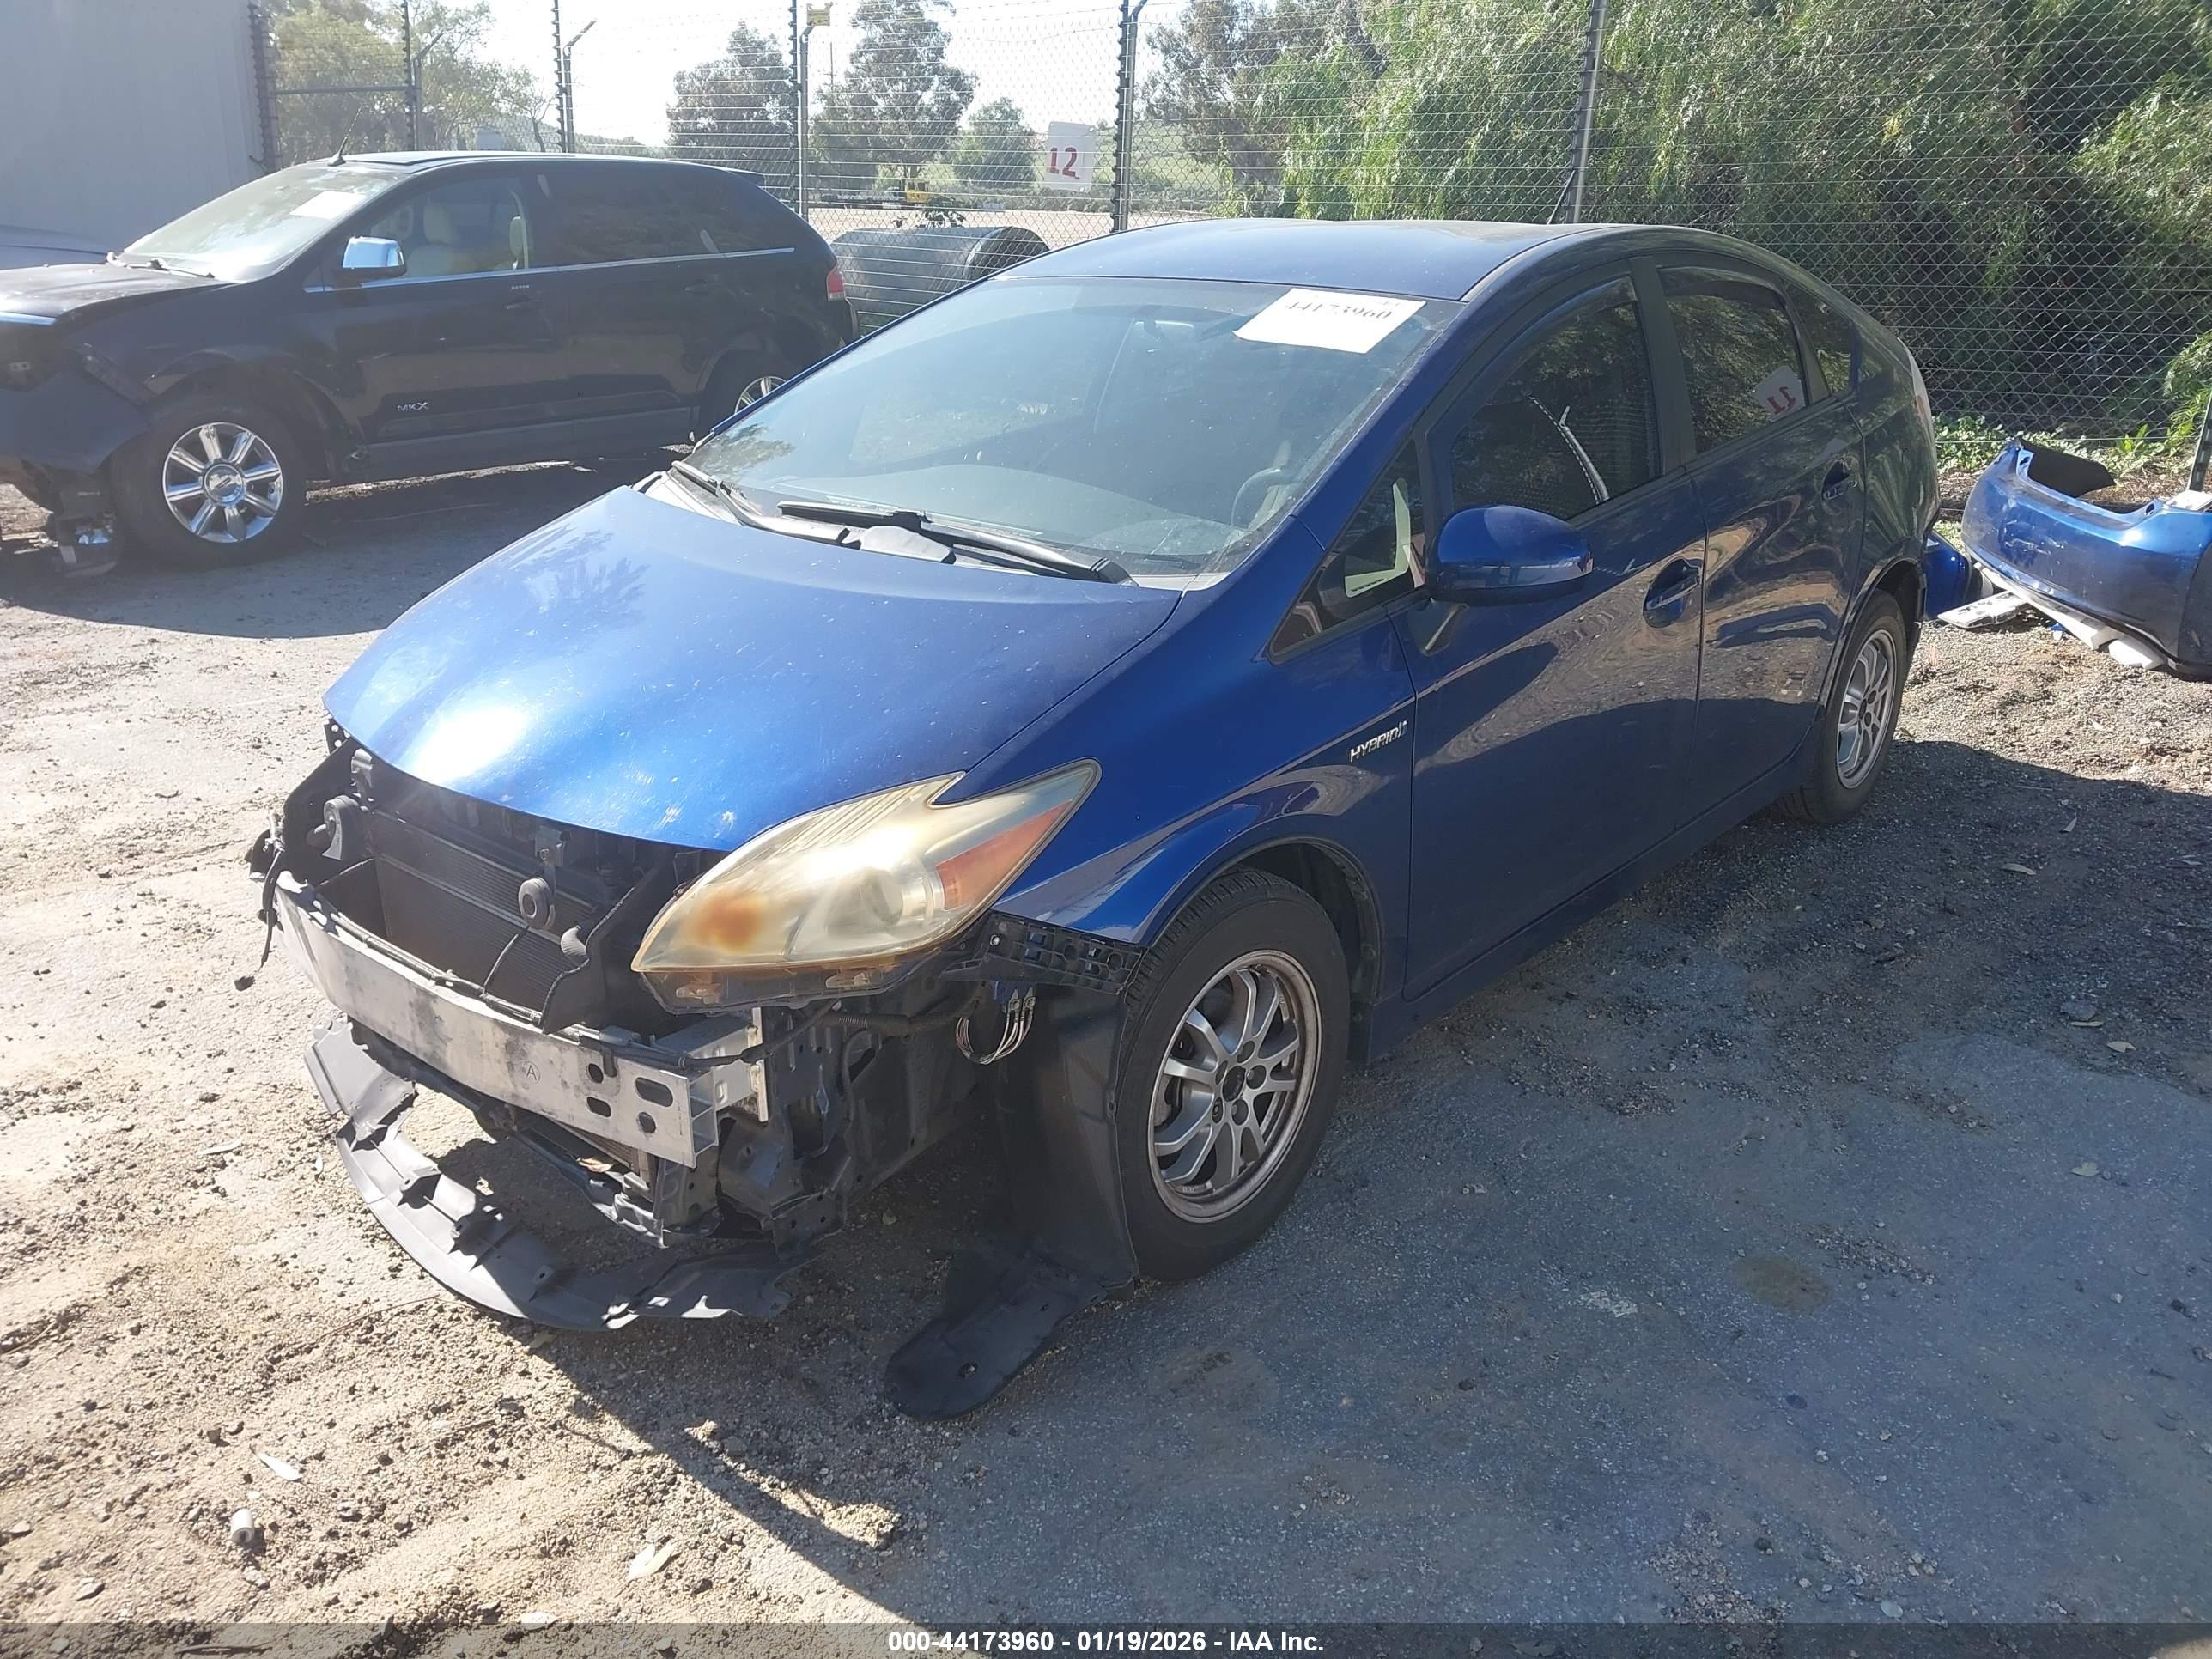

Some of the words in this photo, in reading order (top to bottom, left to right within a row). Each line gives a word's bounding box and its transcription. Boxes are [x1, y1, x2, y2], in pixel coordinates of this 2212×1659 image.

[1048, 146, 1079, 179] 12
[396, 401, 428, 413] MKX
[1349, 726, 1401, 763] HYBRID
[526, 1064, 538, 1082] A
